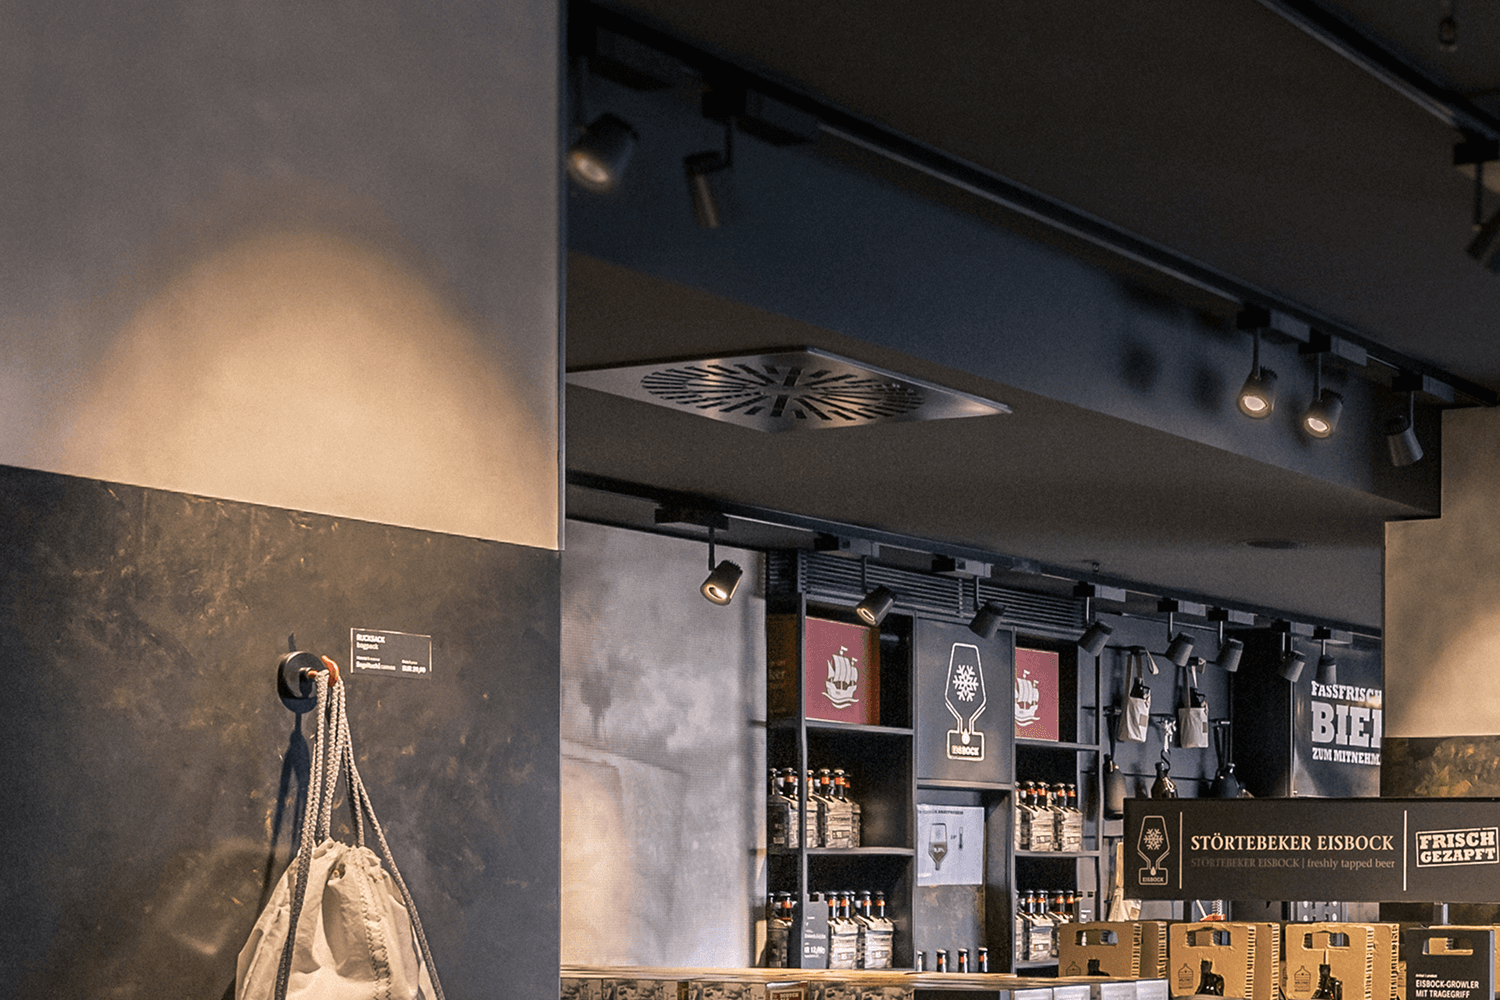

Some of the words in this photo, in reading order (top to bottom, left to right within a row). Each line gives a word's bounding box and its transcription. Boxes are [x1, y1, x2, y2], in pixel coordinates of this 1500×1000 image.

[1312, 747, 1332, 761] ZUM
[1191, 832, 1312, 851] STÖRTEBEKER
[1317, 835, 1394, 851] EISBOCK
[1419, 831, 1495, 850] FRISCH
[1420, 847, 1496, 863] GEZAPFT
[1191, 857, 1256, 868] STÖRTEBEKER
[1258, 857, 1300, 868] EISBOCK
[1307, 858, 1337, 870] freshly
[1341, 860, 1372, 871] tapped
[1375, 858, 1395, 868] beer
[1416, 980, 1480, 989] EISBOCK-GROWLER
[1416, 990, 1428, 998] MIT
[1429, 990, 1470, 999] TRAGEGRIFF
